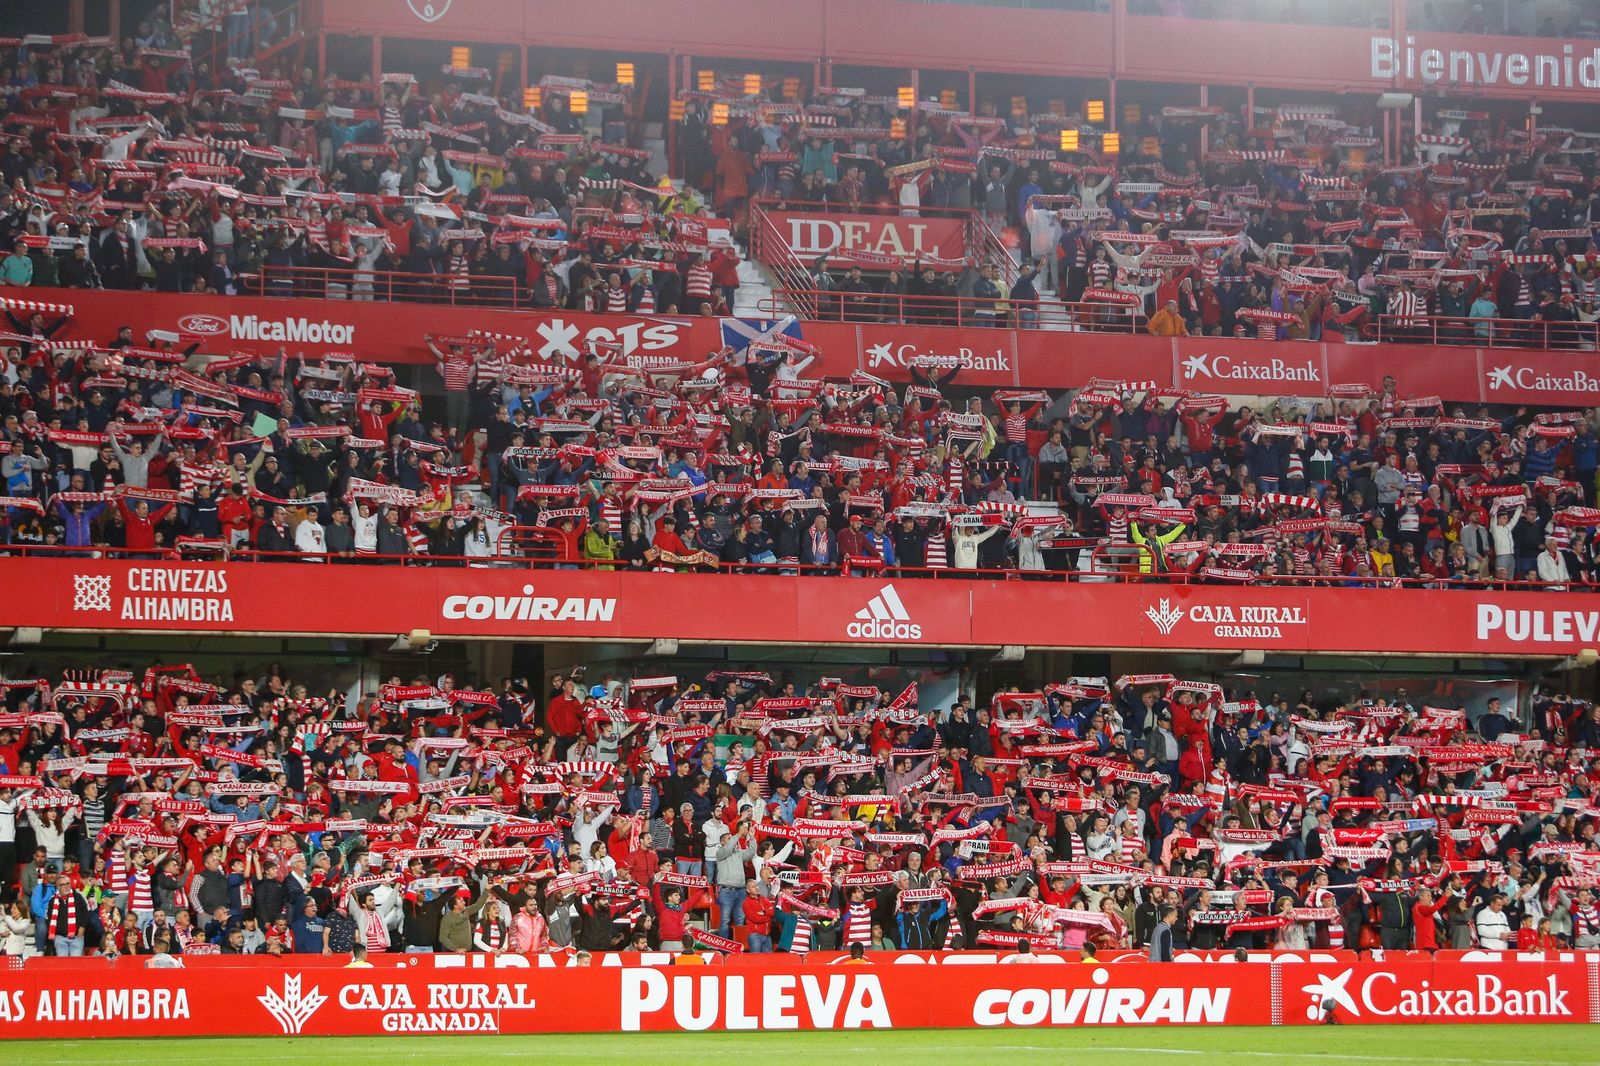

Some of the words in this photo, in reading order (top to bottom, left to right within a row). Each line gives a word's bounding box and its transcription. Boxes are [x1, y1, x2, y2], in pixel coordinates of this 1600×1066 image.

[786, 218, 939, 256] IDEAL
[1094, 291, 1121, 300] GRANADA
[1252, 309, 1282, 318] GRANADA
[188, 317, 218, 331] Ford
[230, 315, 355, 344] MicaMotor
[1212, 356, 1321, 382] CaixaBank
[1516, 367, 1600, 392] CaixaBa
[565, 398, 593, 406] GRANADA
[1315, 424, 1343, 432] GRANADA
[66, 433, 99, 441] GRANADA
[513, 448, 545, 456] GRANADA
[1208, 570, 1249, 578] VAMOS-GRANADA
[128, 567, 228, 593] CERVEZAS
[121, 596, 234, 622] ALHAMBRA
[1190, 605, 1234, 624] CAJA
[1239, 606, 1306, 625] RURAL
[1477, 604, 1600, 642] PULEV
[847, 619, 922, 640] adidas
[1214, 625, 1282, 638] GRANADA
[454, 692, 482, 701] GRANADA
[762, 700, 793, 709] GRANADA
[214, 747, 240, 757] Granada
[1115, 770, 1156, 781] VOLVEREMOS
[369, 783, 390, 791] Lucha
[27, 797, 64, 807] GRANADA
[509, 826, 539, 834] GRANADA
[540, 825, 551, 833] C.F.
[755, 825, 786, 836] GRANADA
[1092, 862, 1112, 872] Granada
[596, 886, 623, 894] GRANADA
[1380, 881, 1408, 889] GRANADA
[1199, 913, 1231, 921] GRANADA
[697, 933, 726, 947] GRANADA
[338, 983, 416, 1011] CAJA
[428, 983, 536, 1009] RURAL
[621, 967, 893, 1032] PULEVA
[1361, 972, 1570, 1017] CaixaBank
[36, 989, 190, 1021] ALHAMBRA
[382, 1013, 498, 1032] GRANADA
